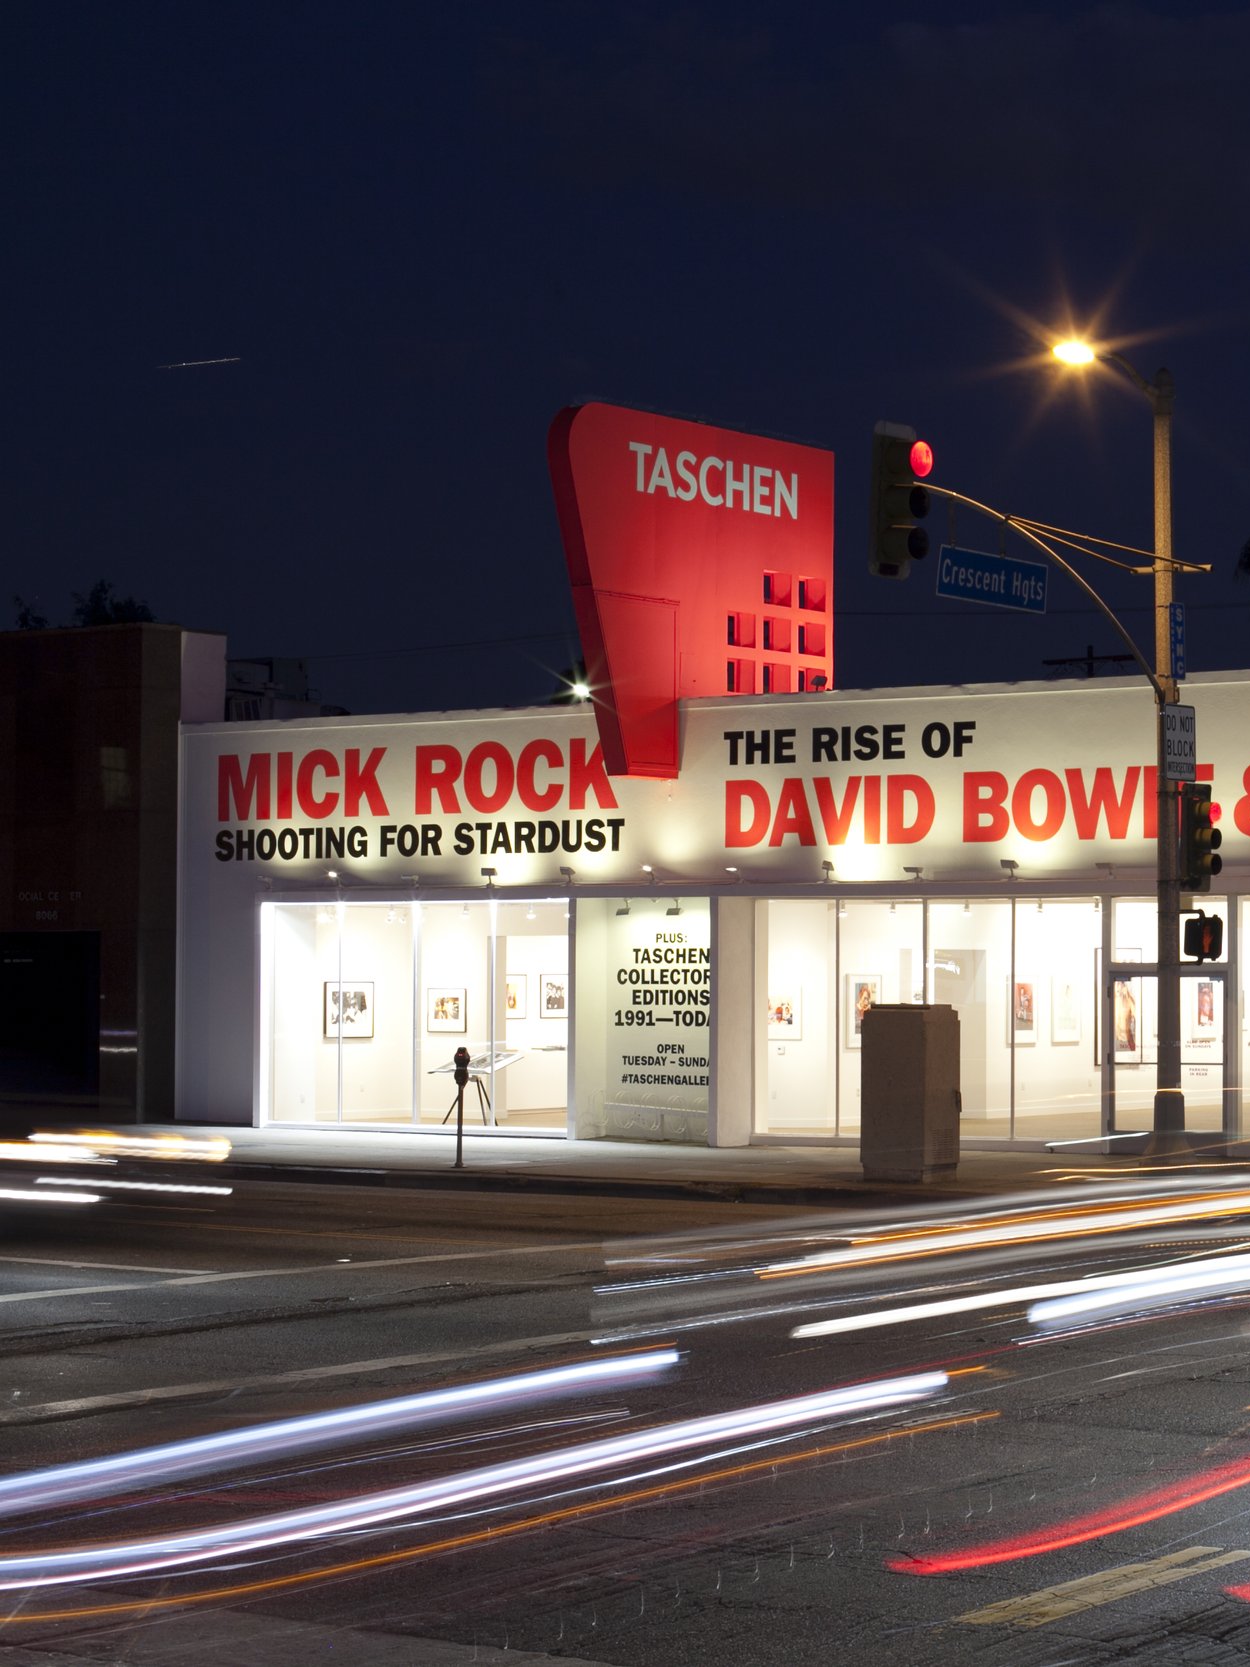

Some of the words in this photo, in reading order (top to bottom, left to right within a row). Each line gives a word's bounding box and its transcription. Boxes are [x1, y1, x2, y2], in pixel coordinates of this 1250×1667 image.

[629, 441, 798, 520] TASCHEN
[942, 558, 1007, 594] Crescent
[1012, 571, 1043, 605] Hgts
[1166, 714, 1177, 732] DO
[1180, 716, 1194, 733] NOT
[724, 729, 797, 765] THE
[812, 723, 906, 763] RISE
[921, 721, 976, 758] OF
[1167, 739, 1194, 758] BLOCK
[218, 747, 389, 822] MICK
[415, 737, 619, 815] ROCK
[725, 773, 936, 848] DAVID
[963, 764, 1214, 843] BOWI
[214, 825, 369, 862] SHOOTING
[379, 823, 442, 857] FOR
[453, 818, 625, 856] STARDUST
[656, 933, 688, 943] PLUS:
[633, 948, 710, 964] TASCHEN
[632, 989, 710, 1006] EDITIONS
[657, 1044, 685, 1054] OPEN
[622, 1056, 667, 1066] TUESDAY
